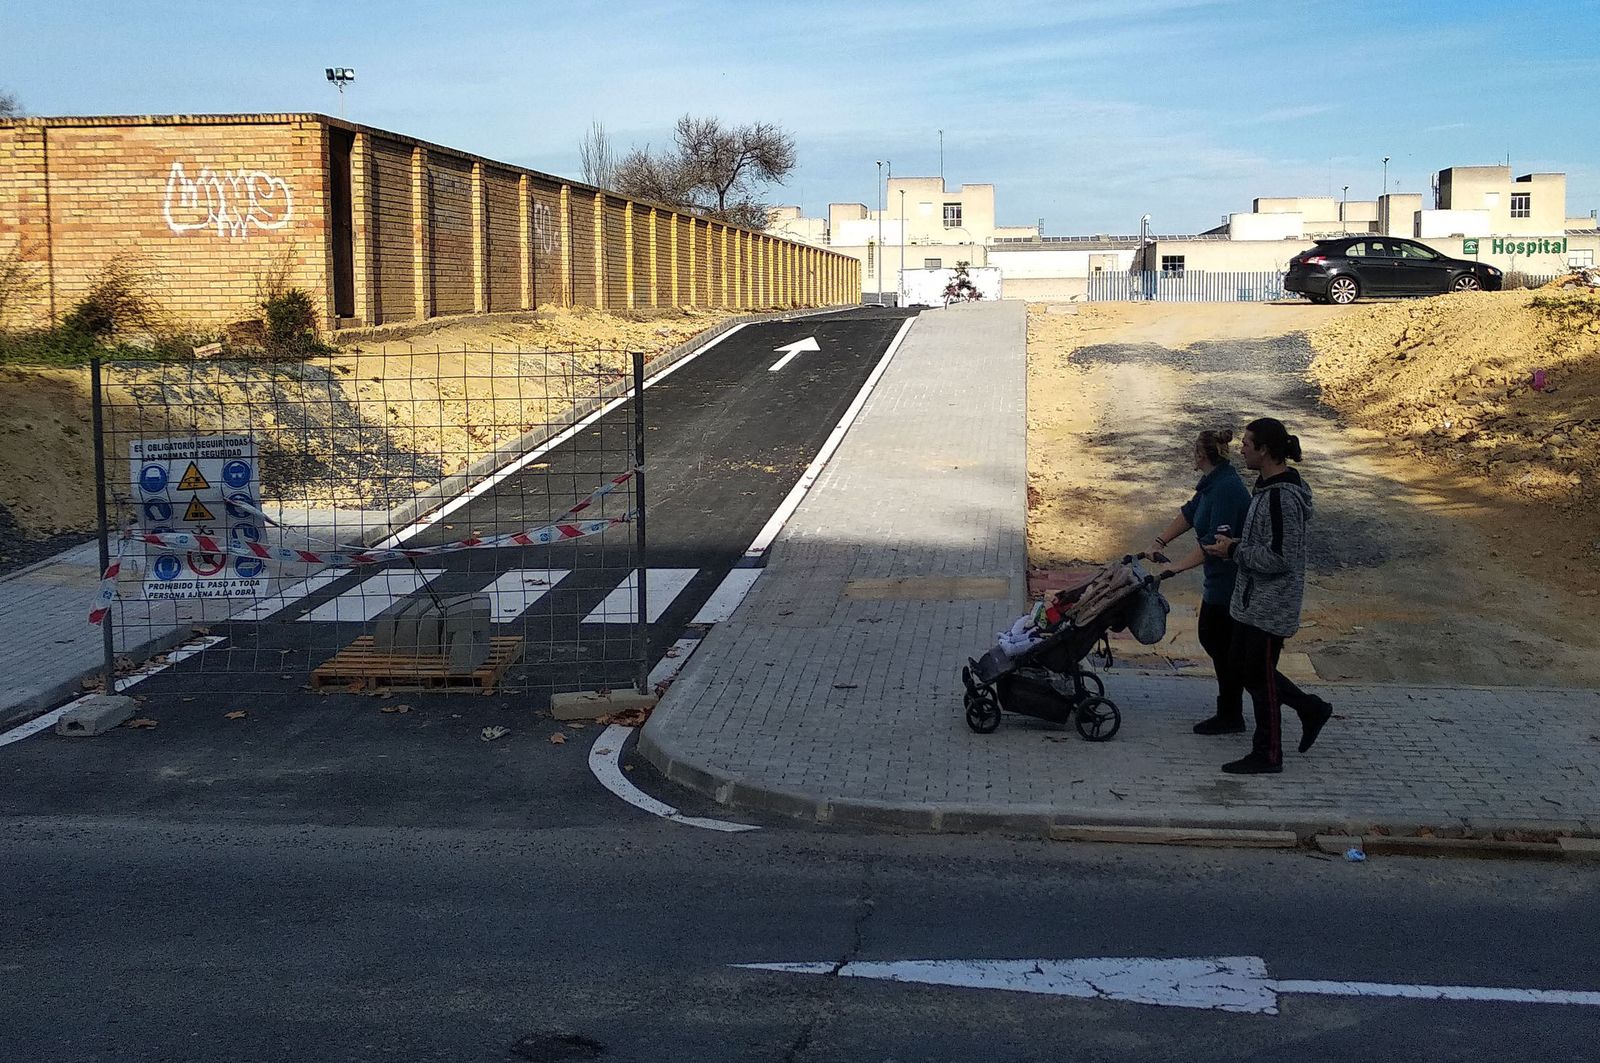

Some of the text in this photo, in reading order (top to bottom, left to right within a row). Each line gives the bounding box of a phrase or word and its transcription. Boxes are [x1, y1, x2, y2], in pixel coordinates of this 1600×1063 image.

[1492, 237, 1568, 257] Hospital
[134, 438, 248, 453] ES OBLIGATORIO SEGUIR TODAS
[158, 452, 188, 460] NORMAS
[201, 449, 242, 458] SEGURIDAD
[148, 582, 193, 590] PROHIBIDO
[148, 592, 185, 600] PERSONA
